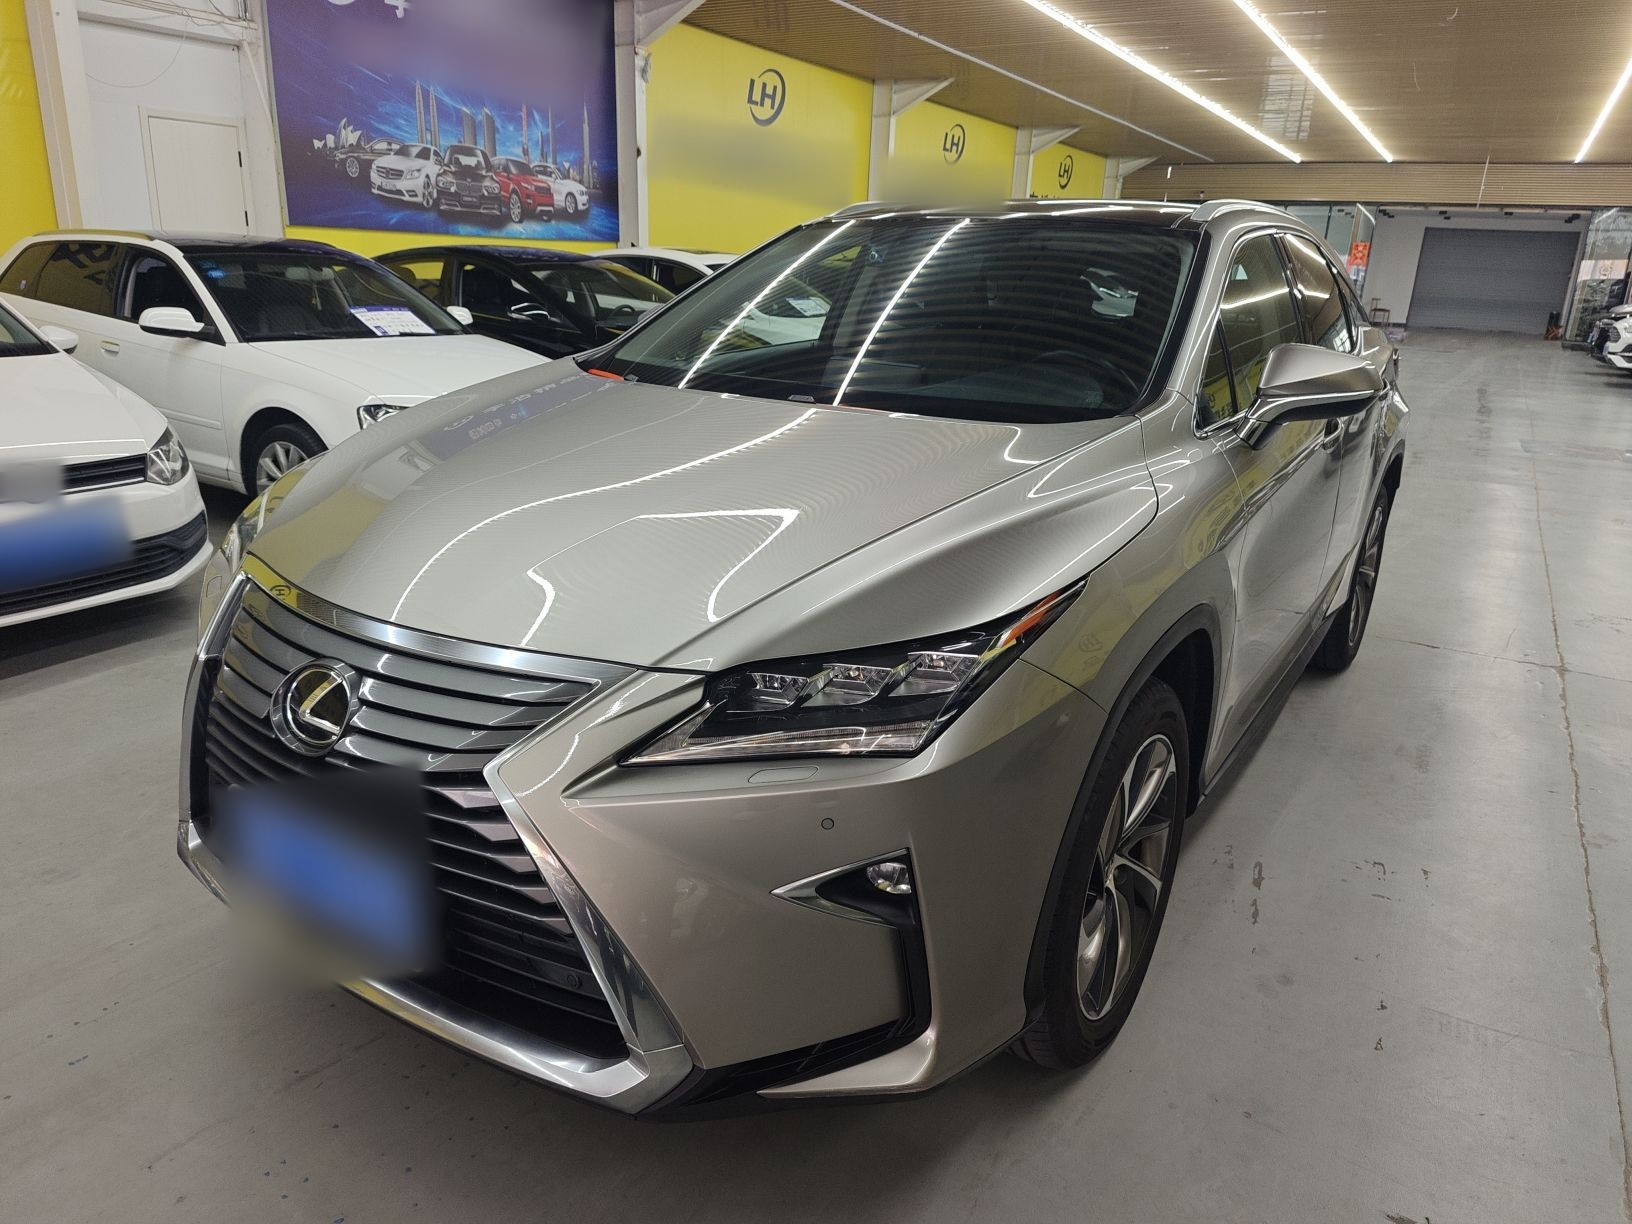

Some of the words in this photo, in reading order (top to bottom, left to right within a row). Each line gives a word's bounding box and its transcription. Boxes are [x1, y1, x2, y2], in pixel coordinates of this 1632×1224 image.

[747, 78, 778, 110] LH
[943, 132, 961, 154] LH
[1058, 161, 1071, 179] LH
